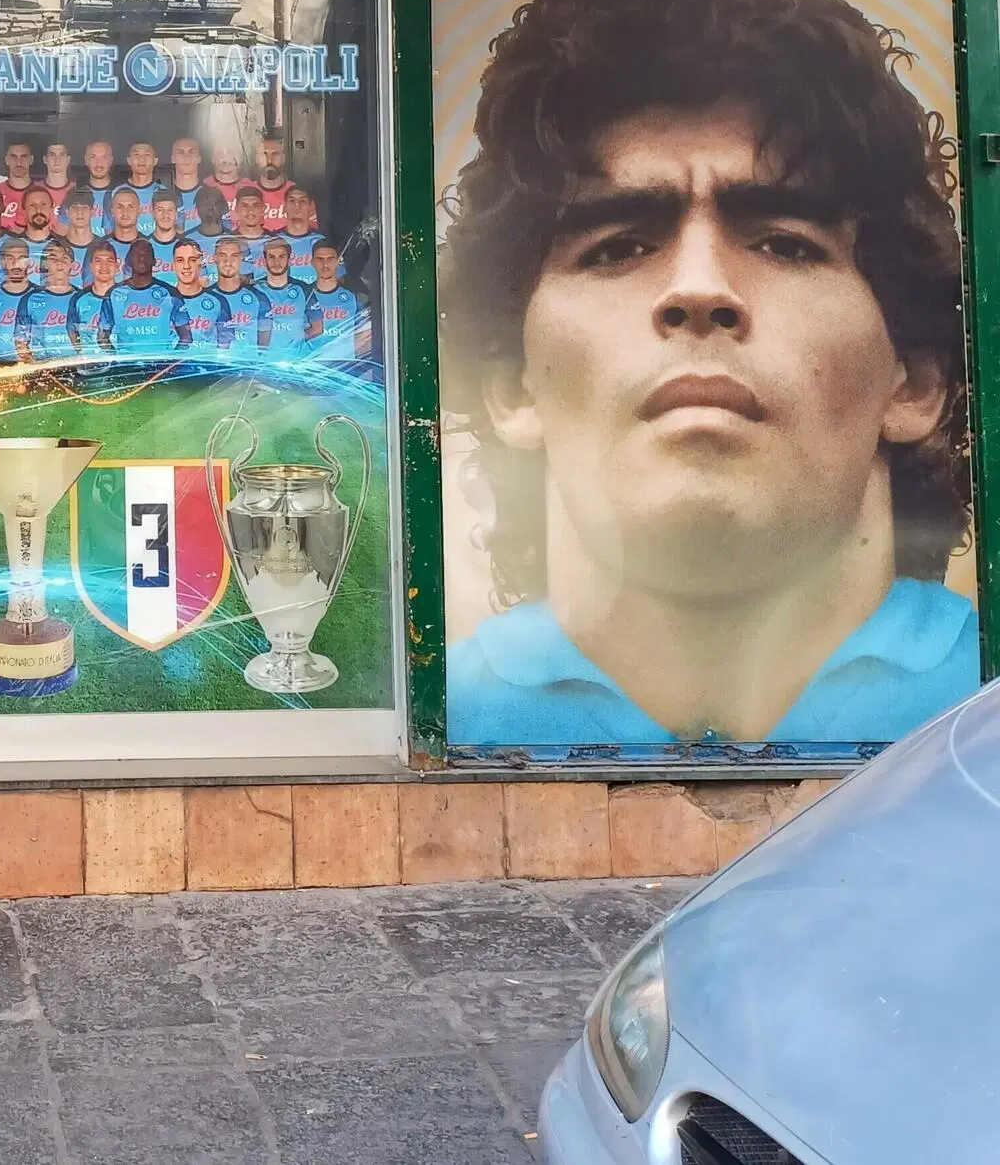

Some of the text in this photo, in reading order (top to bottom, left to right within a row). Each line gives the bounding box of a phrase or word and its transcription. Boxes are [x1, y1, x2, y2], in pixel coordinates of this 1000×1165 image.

[180, 44, 361, 93] NAPOLI
[123, 302, 161, 319] Lete
[188, 316, 211, 330] ete
[230, 312, 252, 326] ete
[136, 326, 158, 335] MSC
[131, 503, 170, 588] 3
